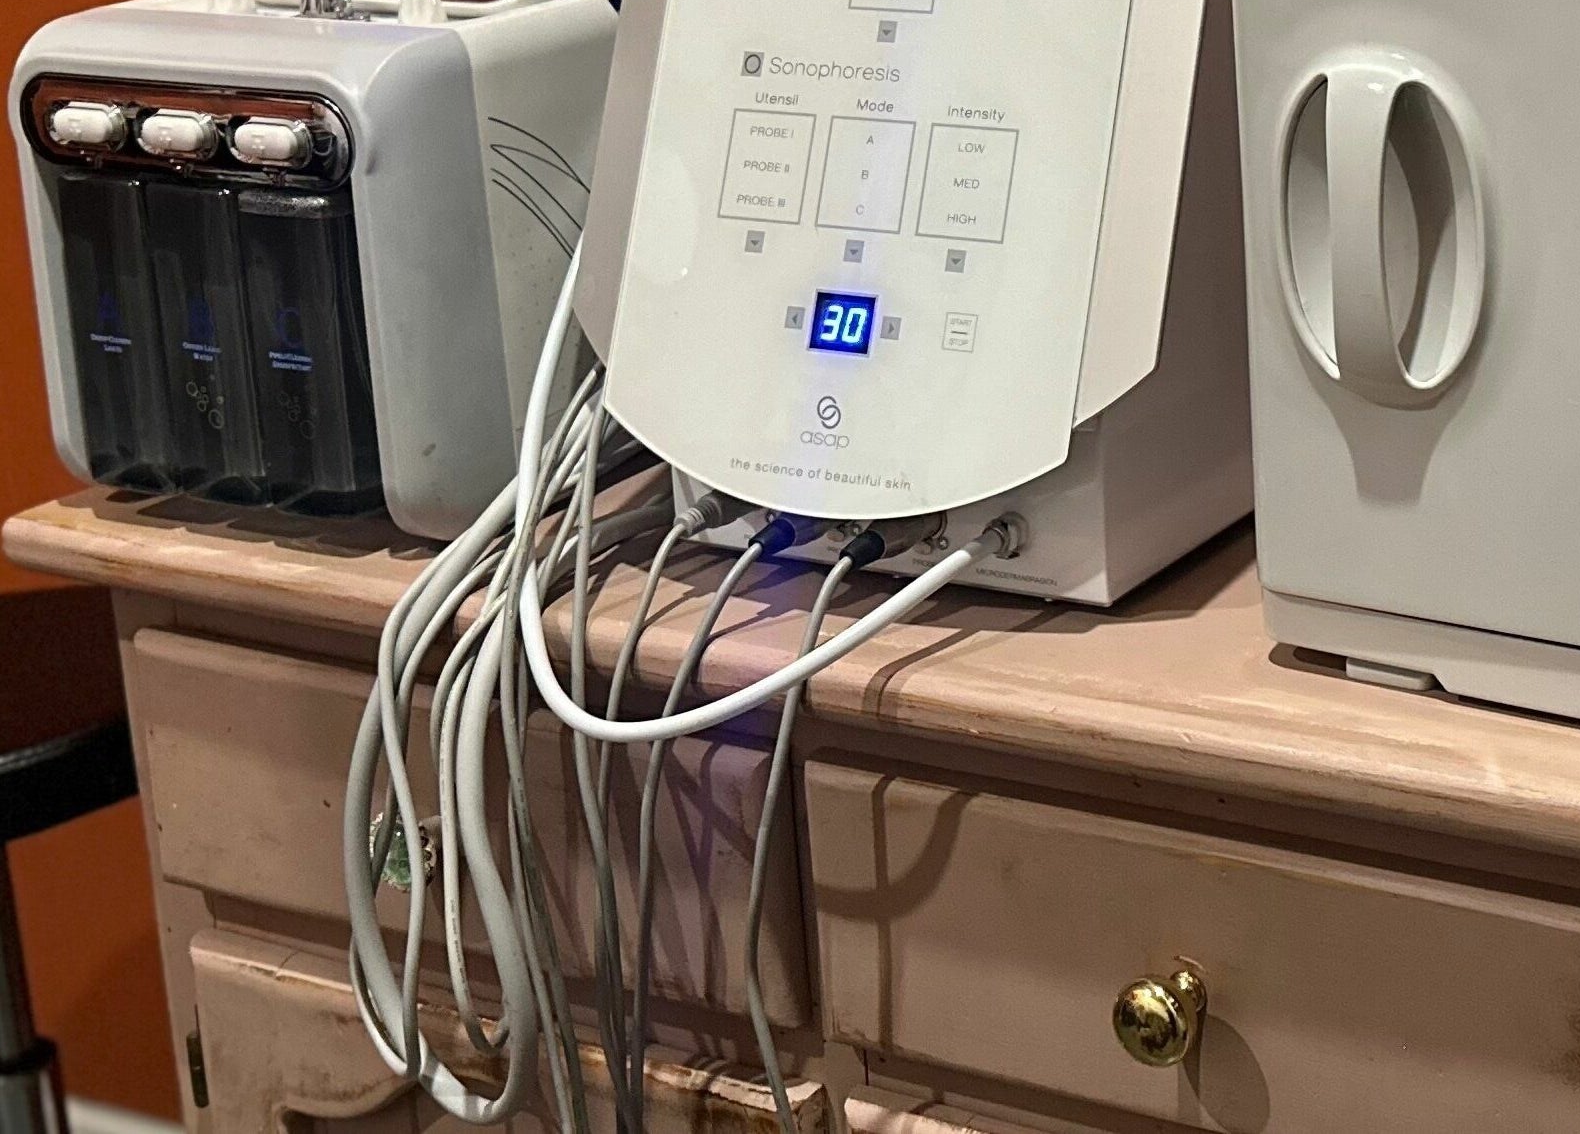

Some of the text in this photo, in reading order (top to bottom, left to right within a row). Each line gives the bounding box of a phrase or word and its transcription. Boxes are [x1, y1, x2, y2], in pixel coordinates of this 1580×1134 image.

[768, 56, 901, 83] Sonophoresis
[754, 91, 799, 106] Utensil
[856, 98, 894, 114] Mode
[947, 105, 1006, 124] Intensity
[750, 125, 789, 139] PROBE
[866, 135, 875, 147] A
[957, 142, 986, 154] LOW
[743, 159, 782, 173] PROBE
[861, 169, 870, 181] B
[953, 177, 981, 190] MED
[736, 193, 775, 207] PROBE
[855, 204, 865, 216] C
[946, 213, 977, 225] HIGH
[820, 305, 869, 344] 30
[799, 430, 850, 451] asap
[730, 457, 912, 491] the science of beautiful skin
